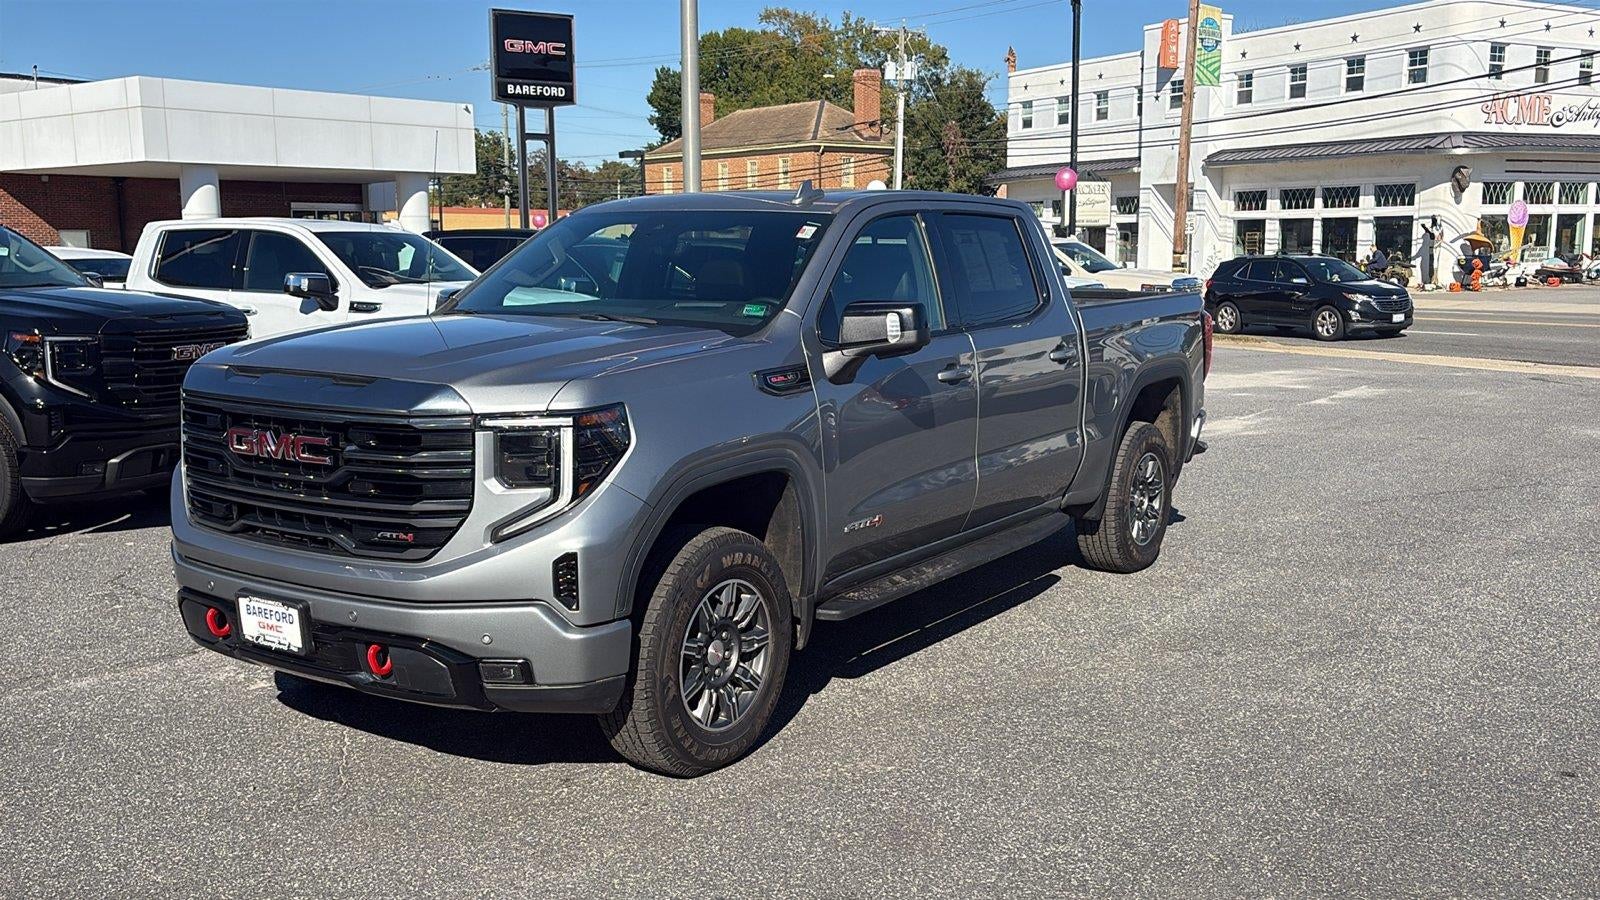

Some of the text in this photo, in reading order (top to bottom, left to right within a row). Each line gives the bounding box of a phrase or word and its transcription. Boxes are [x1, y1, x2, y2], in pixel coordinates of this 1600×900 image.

[504, 39, 566, 56] GMC
[1168, 23, 1176, 64] ACME
[507, 84, 566, 97] BAREFORD
[1481, 92, 1553, 126] ACME
[228, 427, 333, 465] GMC
[245, 604, 294, 625] BAREFORD
[258, 621, 284, 633] GMC
